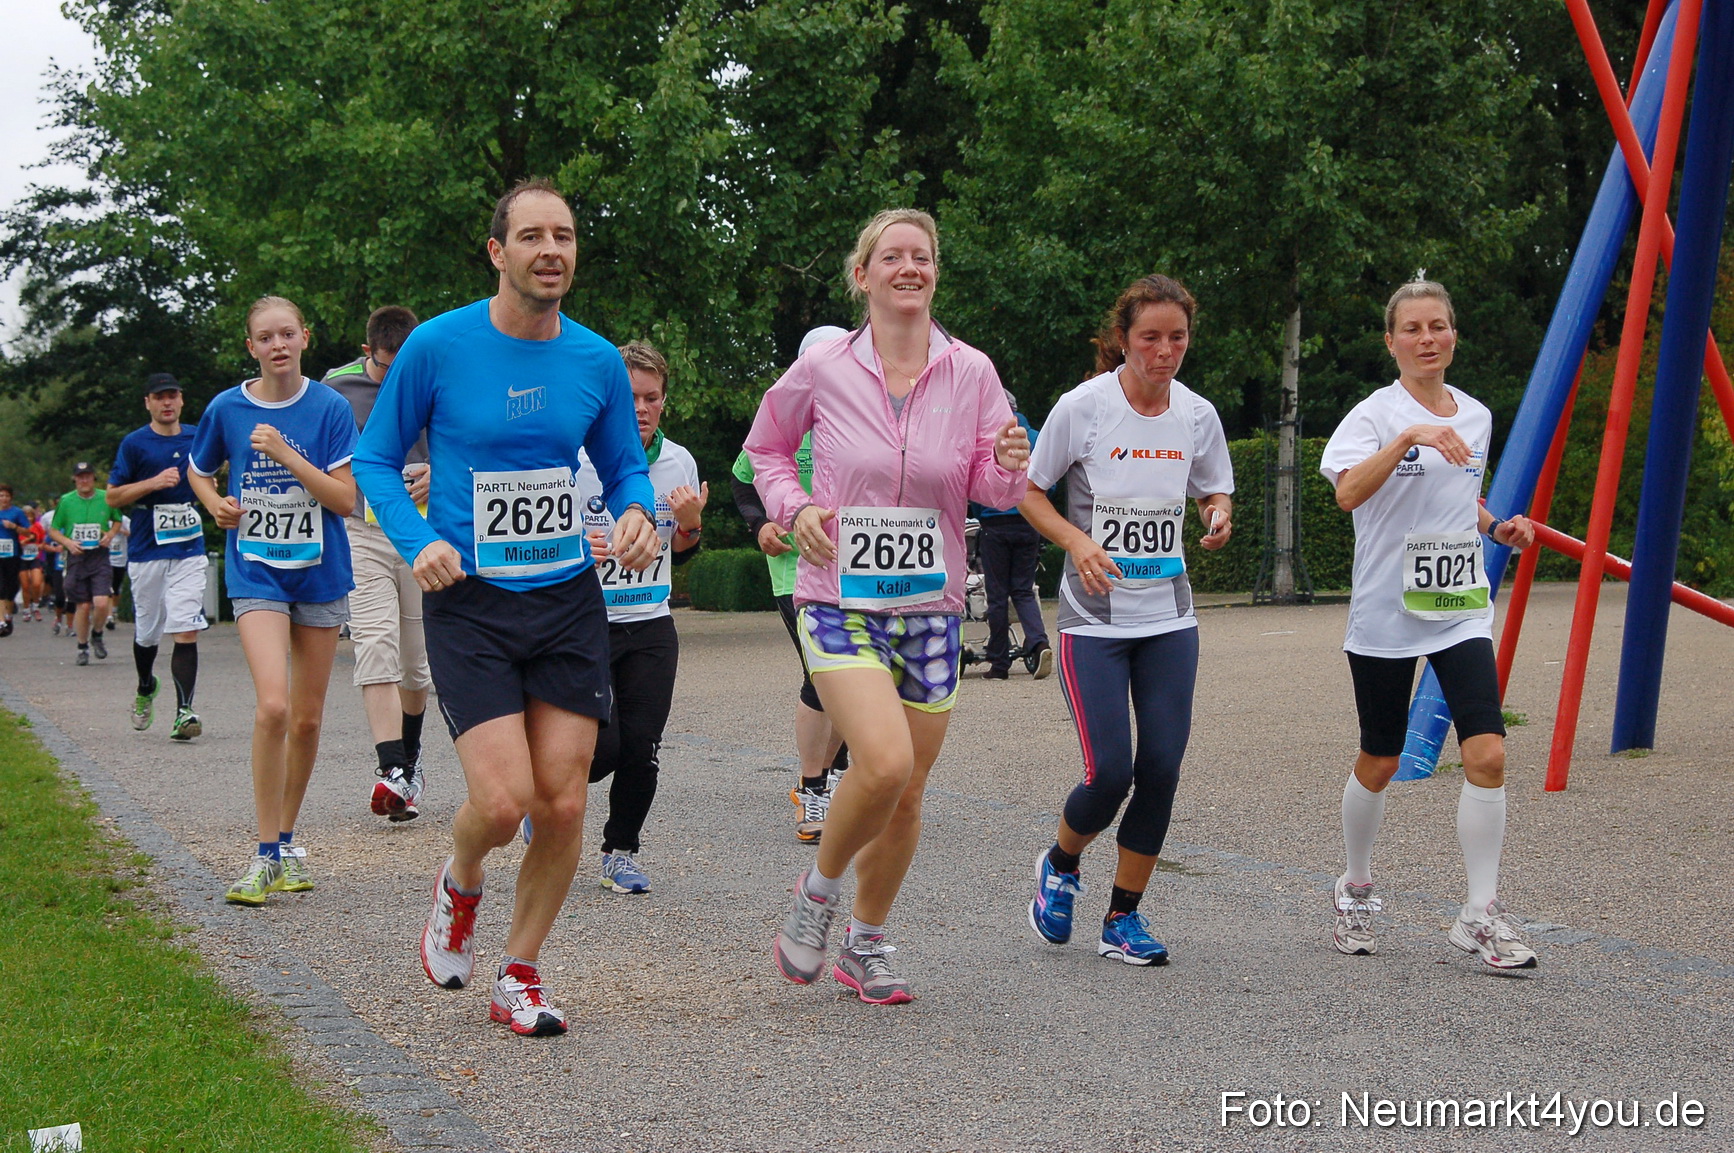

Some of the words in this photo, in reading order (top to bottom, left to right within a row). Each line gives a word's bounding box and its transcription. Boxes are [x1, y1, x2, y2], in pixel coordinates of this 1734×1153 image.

[506, 386, 547, 421] RUN
[1132, 449, 1185, 461] KLEBL
[251, 469, 292, 478] Neumarkte
[476, 483, 515, 493] PARTL
[517, 479, 566, 491] Neumarkt
[242, 496, 267, 506] PARTL
[267, 501, 306, 510] Neumarkt
[486, 493, 573, 537] 2629
[1095, 504, 1129, 516] PARTL
[1130, 508, 1172, 517] Neumarkt
[247, 509, 315, 540] 2874
[585, 515, 610, 523] PARTL
[841, 517, 878, 528] PARTL
[880, 518, 924, 528] Neumarkt
[74, 530, 99, 540] 3143
[1101, 519, 1176, 554] 2690
[266, 546, 292, 559] Nina
[504, 543, 560, 562] Michael
[850, 532, 935, 570] 2628
[1406, 542, 1439, 552] PARTL
[1441, 541, 1474, 550] Neumarkt
[1115, 561, 1162, 578] Sylvana
[1414, 552, 1477, 589] 5021
[876, 580, 911, 596] Katja
[611, 592, 653, 604] Johanna
[1435, 595, 1466, 608] doris
